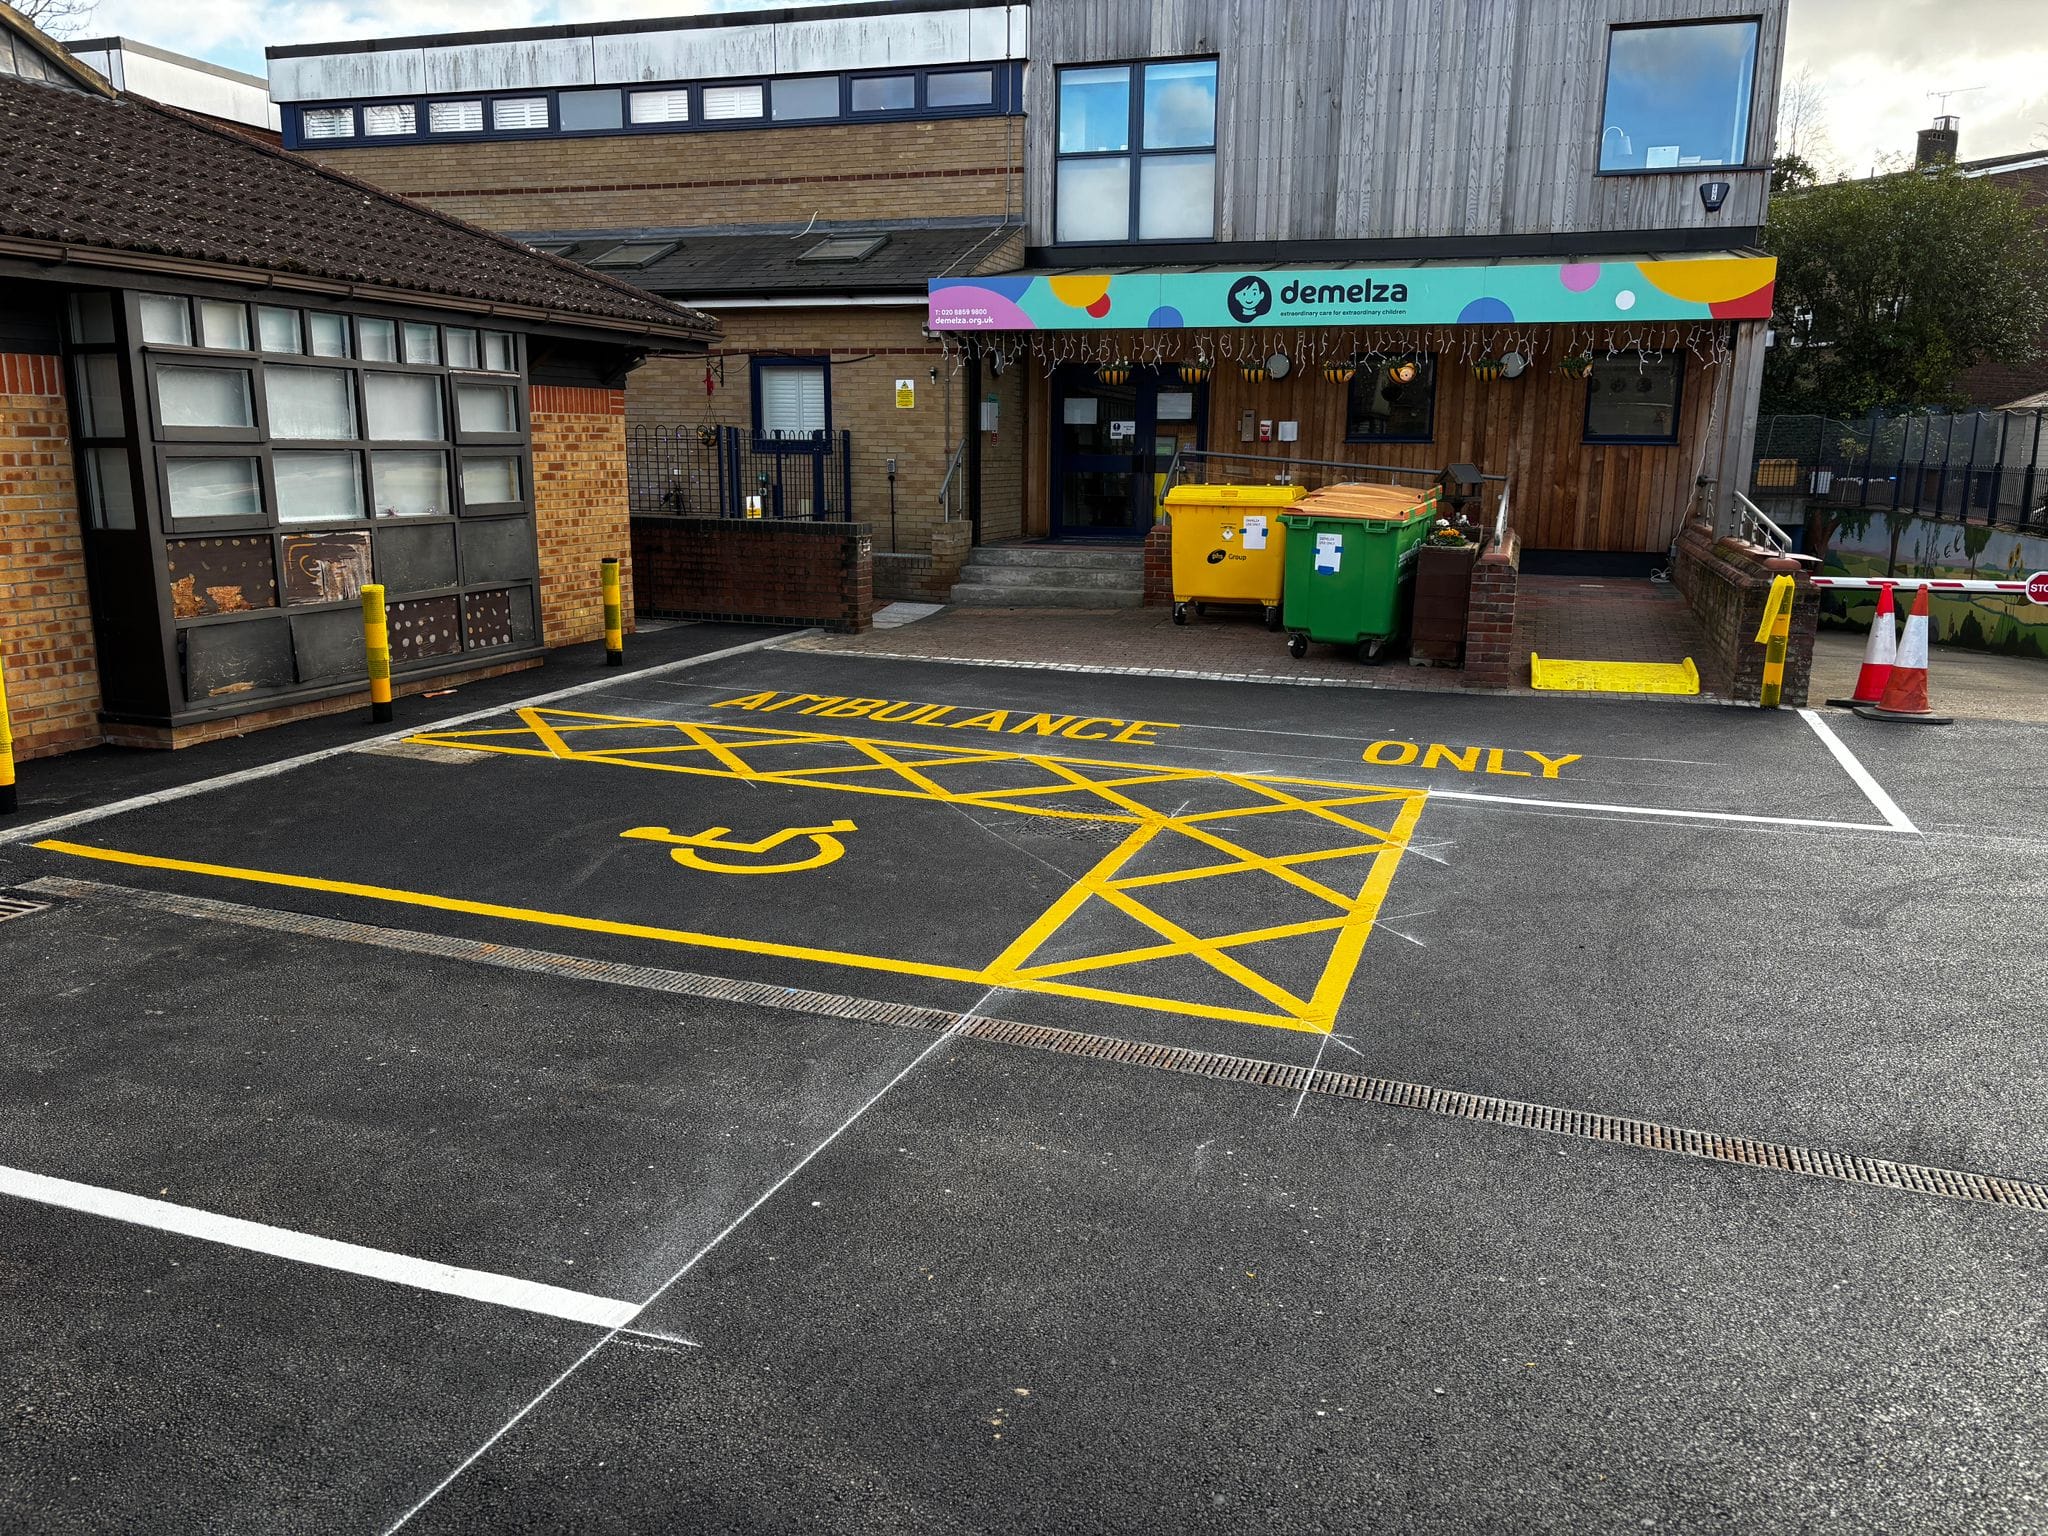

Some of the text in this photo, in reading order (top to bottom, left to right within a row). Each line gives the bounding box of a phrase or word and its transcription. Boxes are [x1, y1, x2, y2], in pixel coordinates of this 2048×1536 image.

[1280, 278, 1408, 304] demelza
[1342, 309, 1381, 317] extraordinary
[935, 316, 994, 326] demelza.org.uk
[1228, 553, 1247, 561] Group
[709, 690, 1582, 779] AMBULANCE ONLY
